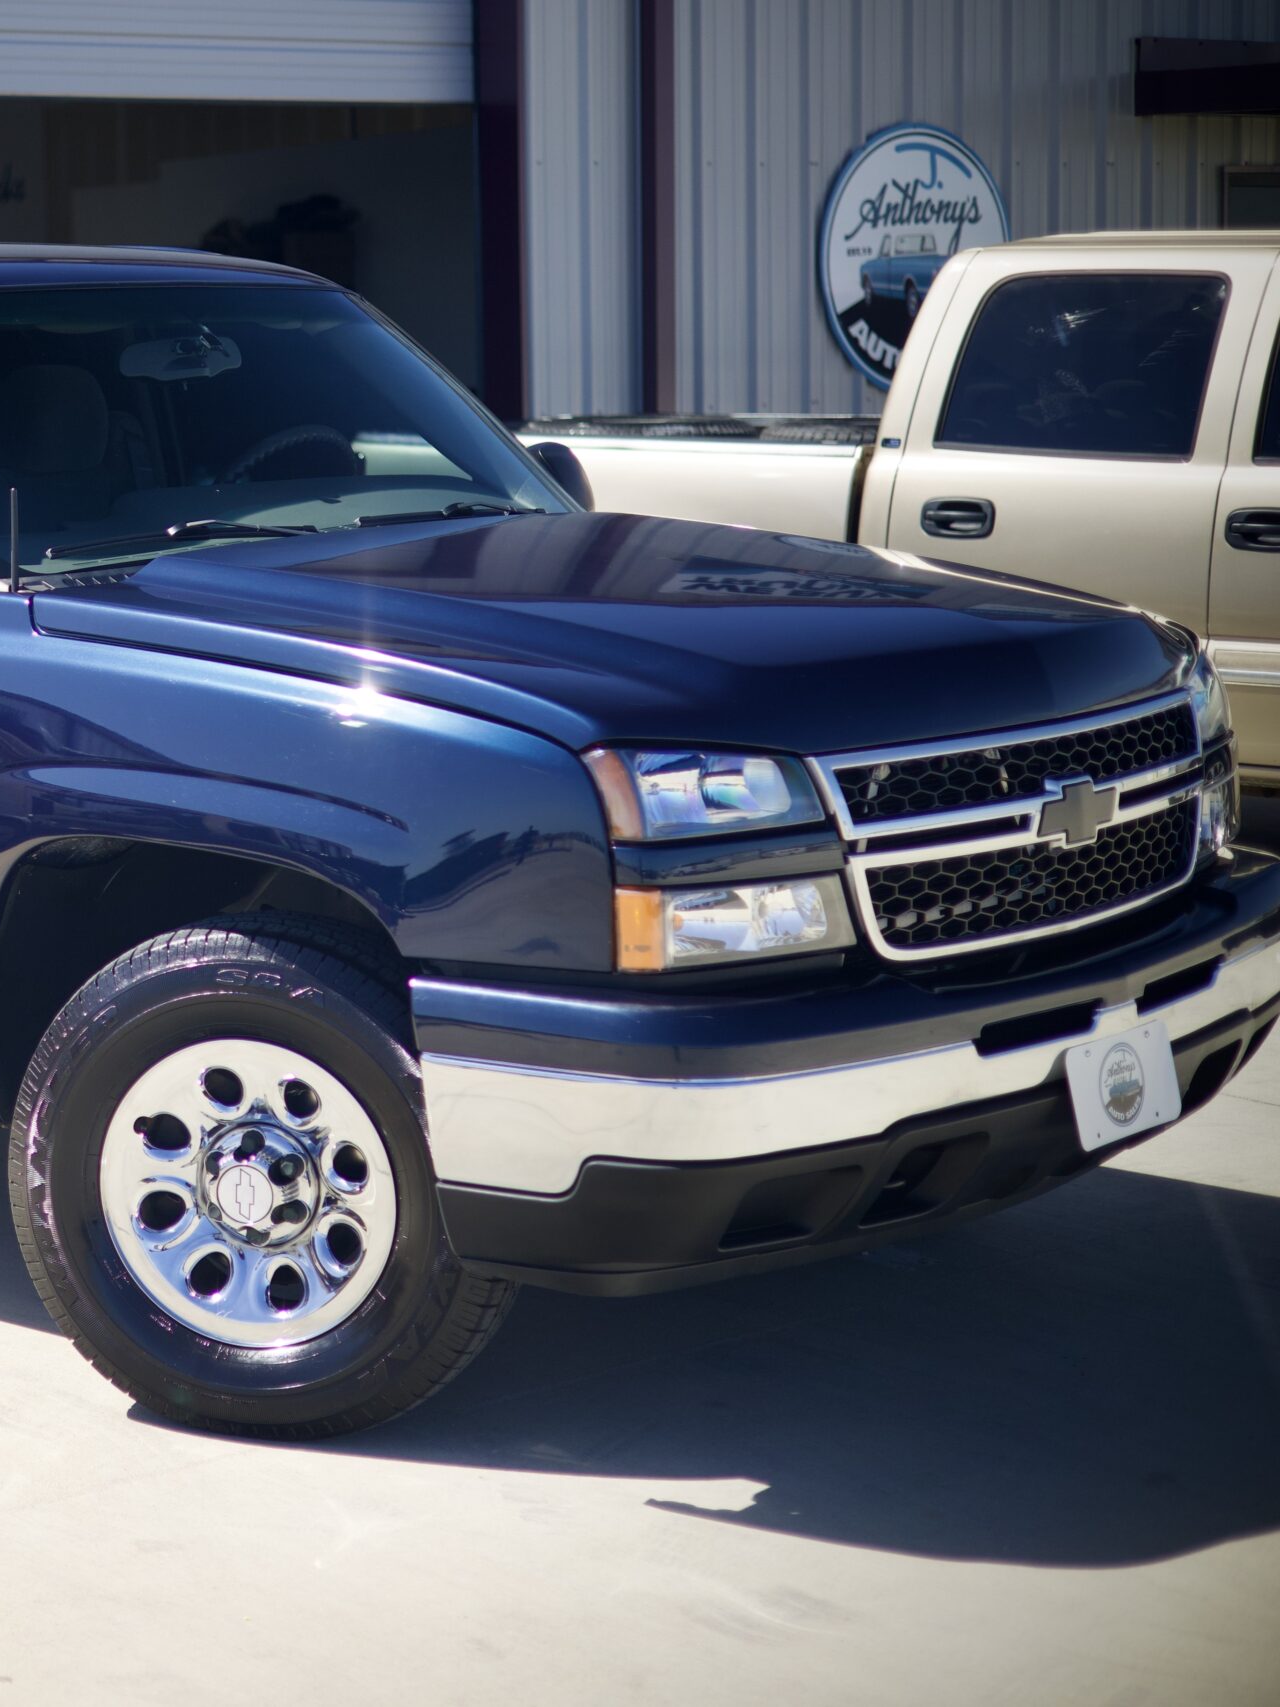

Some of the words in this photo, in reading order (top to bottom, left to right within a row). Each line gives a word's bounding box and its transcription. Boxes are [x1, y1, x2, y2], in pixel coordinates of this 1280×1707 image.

[894, 142, 972, 190] J.
[844, 178, 982, 253] Anthony's
[848, 319, 901, 371] AUT
